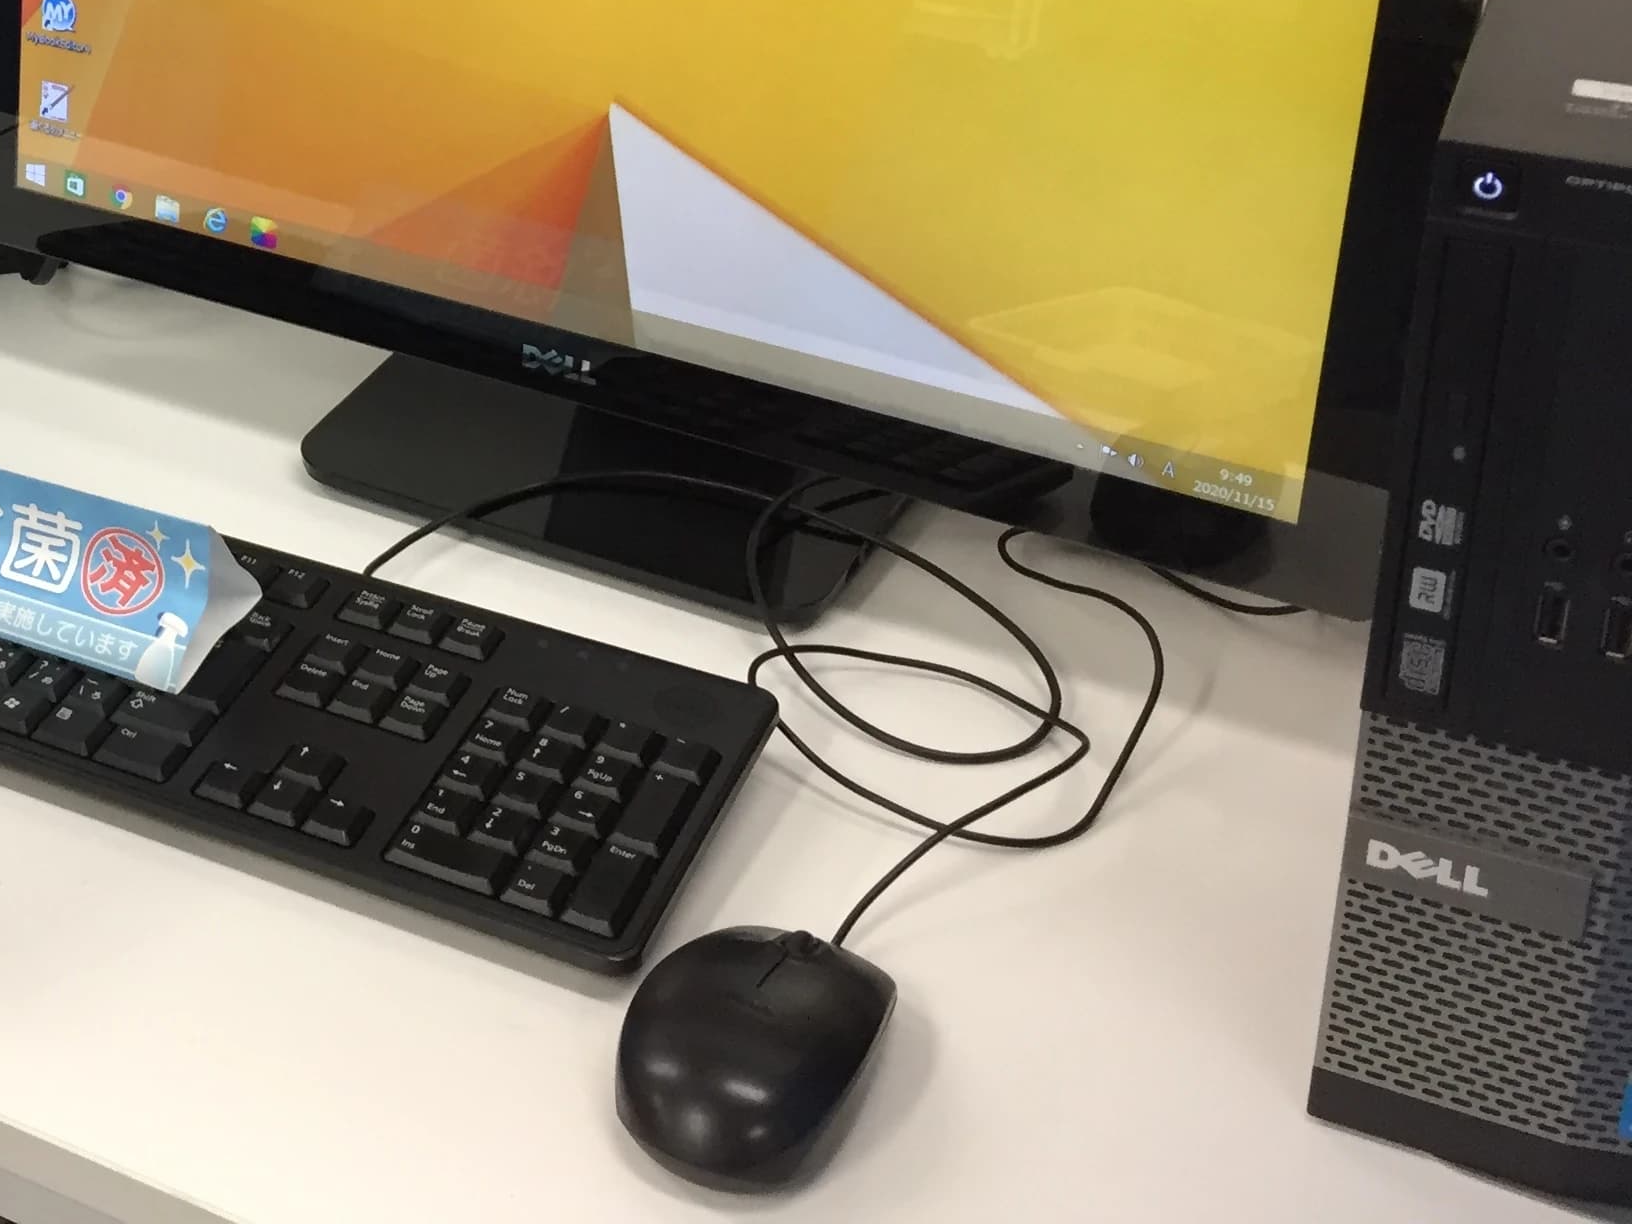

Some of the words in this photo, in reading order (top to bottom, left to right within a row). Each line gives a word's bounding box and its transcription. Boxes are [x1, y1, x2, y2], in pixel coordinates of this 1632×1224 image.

[521, 343, 597, 386] DELL
[1220, 468, 1254, 487] 9:49
[1192, 479, 1275, 512] 2020/11/15
[325, 633, 350, 647] Insert
[375, 648, 401, 661] Home
[300, 663, 328, 677] Delete
[351, 679, 369, 691] End
[135, 690, 157, 704] Shift
[506, 687, 528, 701] Num
[121, 727, 137, 739] Ctrl
[475, 733, 502, 748] Home
[587, 768, 614, 783] PgUp
[426, 802, 446, 816] End
[401, 838, 415, 850] Ins
[541, 840, 568, 856] PgDn
[609, 845, 636, 861] Enter
[1366, 838, 1489, 898] DELL
[518, 878, 536, 891] Del
